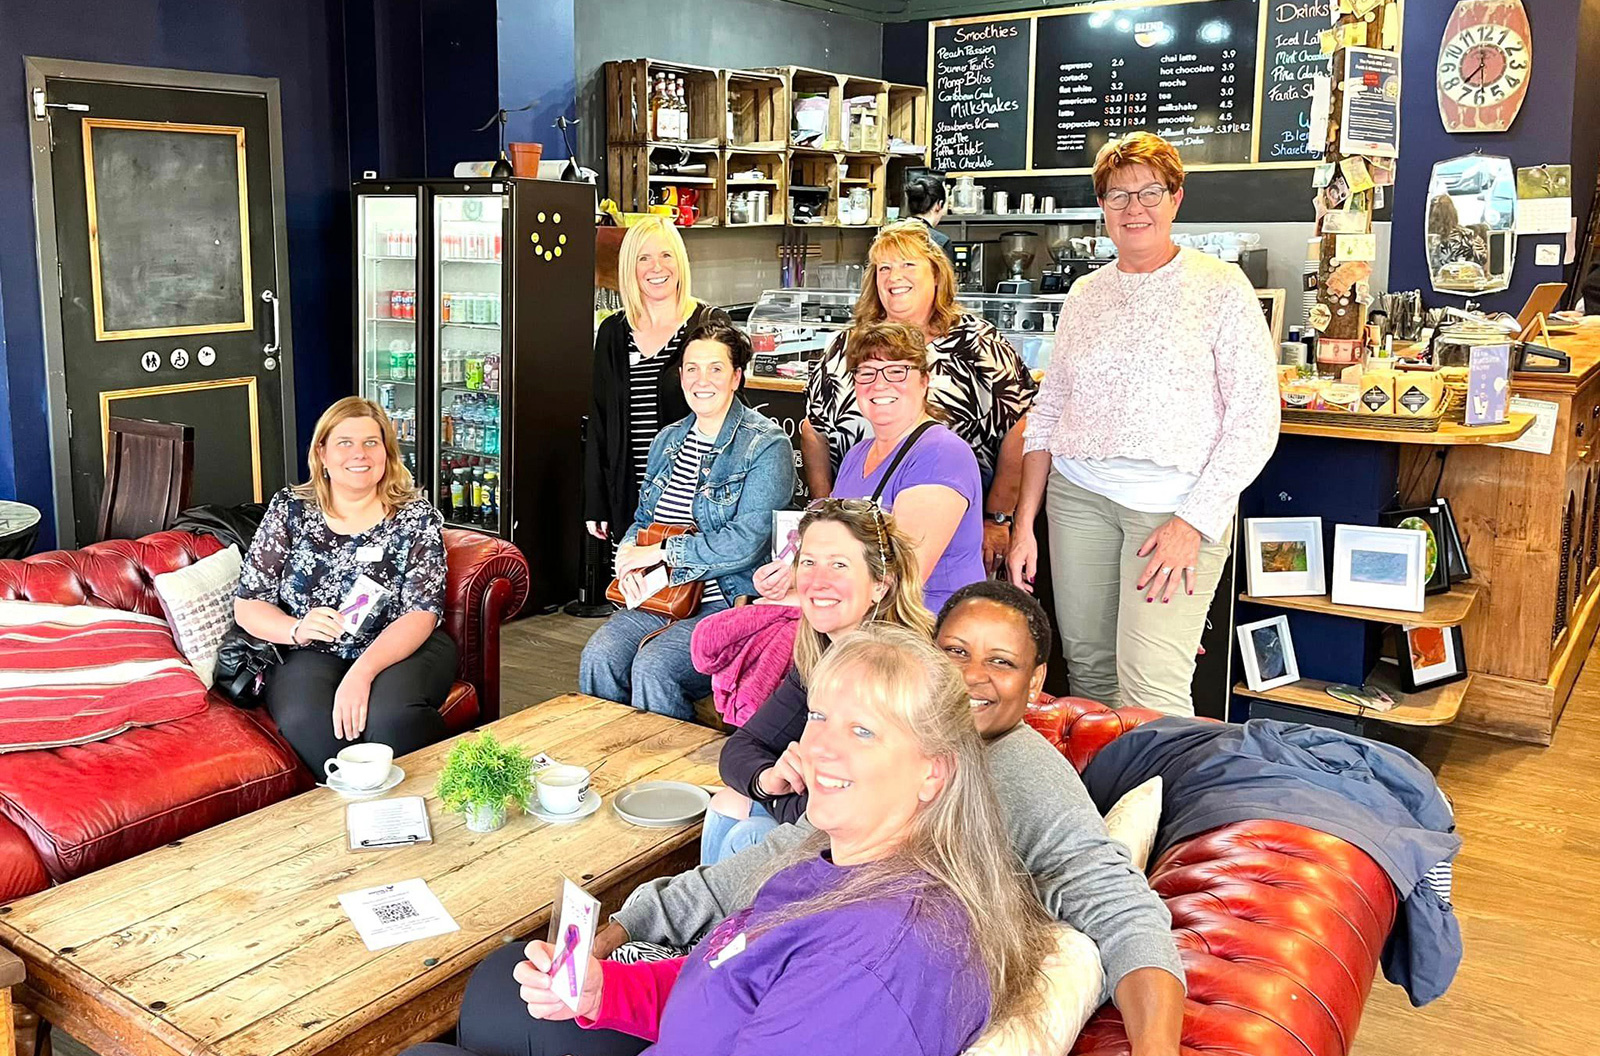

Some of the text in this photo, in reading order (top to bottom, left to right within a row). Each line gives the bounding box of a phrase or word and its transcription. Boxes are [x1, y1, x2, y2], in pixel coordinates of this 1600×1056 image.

[1275, 0, 1330, 22] Drinks
[954, 24, 1018, 42] Smoothies
[1275, 32, 1300, 48] Iced
[1460, 30, 1476, 47] 11
[1477, 26, 1494, 41] 12
[1497, 29, 1510, 45] 1
[937, 44, 996, 59] Peach Passion
[1446, 44, 1463, 59] 10
[1505, 41, 1523, 56] 2
[1111, 58, 1124, 67] 2.6
[1160, 54, 1177, 63] chai
[1222, 50, 1236, 59] 3.9
[1276, 50, 1298, 64] Mint
[1175, 65, 1215, 74] chocolate
[1221, 63, 1235, 71] 3.9
[1440, 62, 1456, 73] 9
[1509, 60, 1527, 70] 3
[938, 71, 992, 90] Mango Bliss
[1059, 70, 1117, 82] cortado 3
[1159, 75, 1234, 87] mocha 4.0
[1505, 74, 1520, 88] 4
[1111, 82, 1124, 90] 3.2
[1444, 77, 1460, 91] 8
[1104, 94, 1122, 103] S3.0
[1129, 92, 1147, 101] R3.2
[1220, 88, 1234, 96] 3.0
[1268, 83, 1300, 101] Fanta
[1457, 86, 1473, 102] 7
[1474, 89, 1485, 105] 6
[1490, 85, 1505, 102] 5
[951, 97, 1019, 118] Milkshakes
[1128, 105, 1146, 113] R3.4
[1219, 100, 1233, 108] 4.5
[1128, 117, 1146, 126] R3.4
[1158, 113, 1232, 124] smoothie 4.5
[954, 140, 984, 156] Tablet
